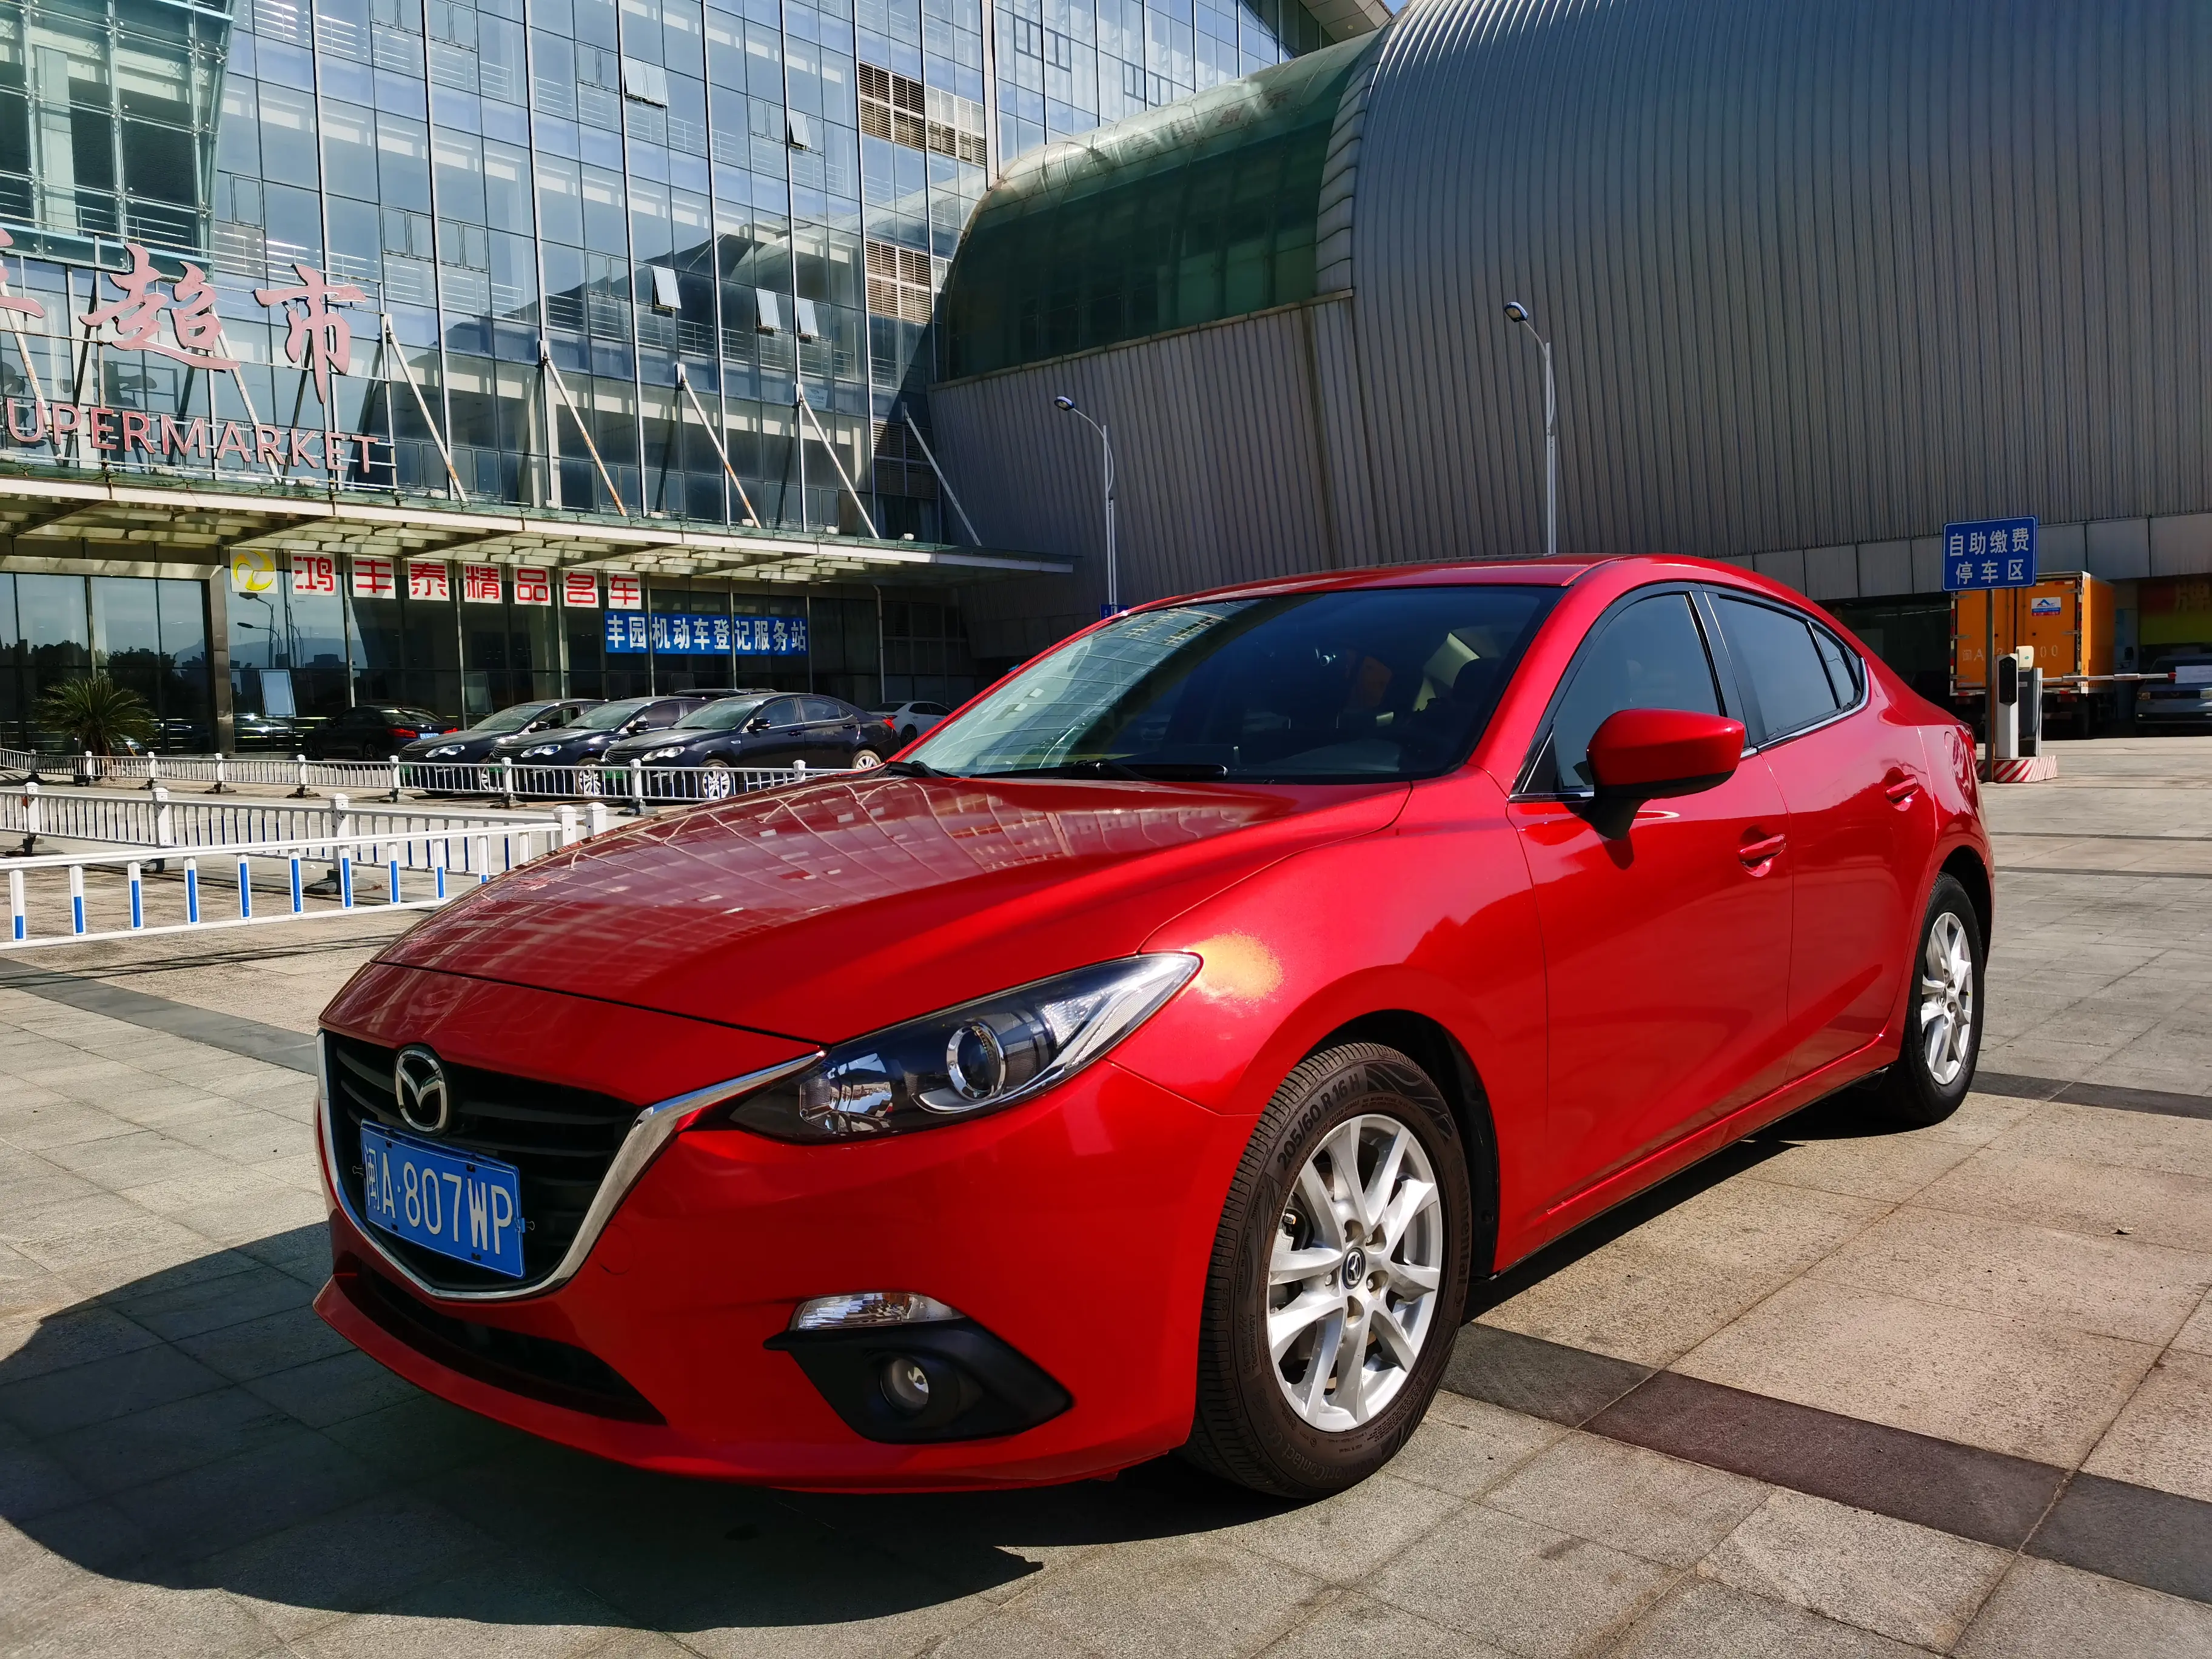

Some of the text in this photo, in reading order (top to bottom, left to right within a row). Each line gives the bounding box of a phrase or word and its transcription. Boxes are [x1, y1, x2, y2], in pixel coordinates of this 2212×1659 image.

[0, 228, 367, 404] 超市
[7, 397, 378, 474] UPERMARKET
[1949, 527, 2029, 557] 自助缴费
[293, 555, 640, 606] 鸿丰泰精品名车
[1956, 558, 2024, 585] 停车区
[607, 614, 806, 652] 丰园机动车登记服务站
[1276, 1072, 1361, 1171] 205/60 R 16 H
